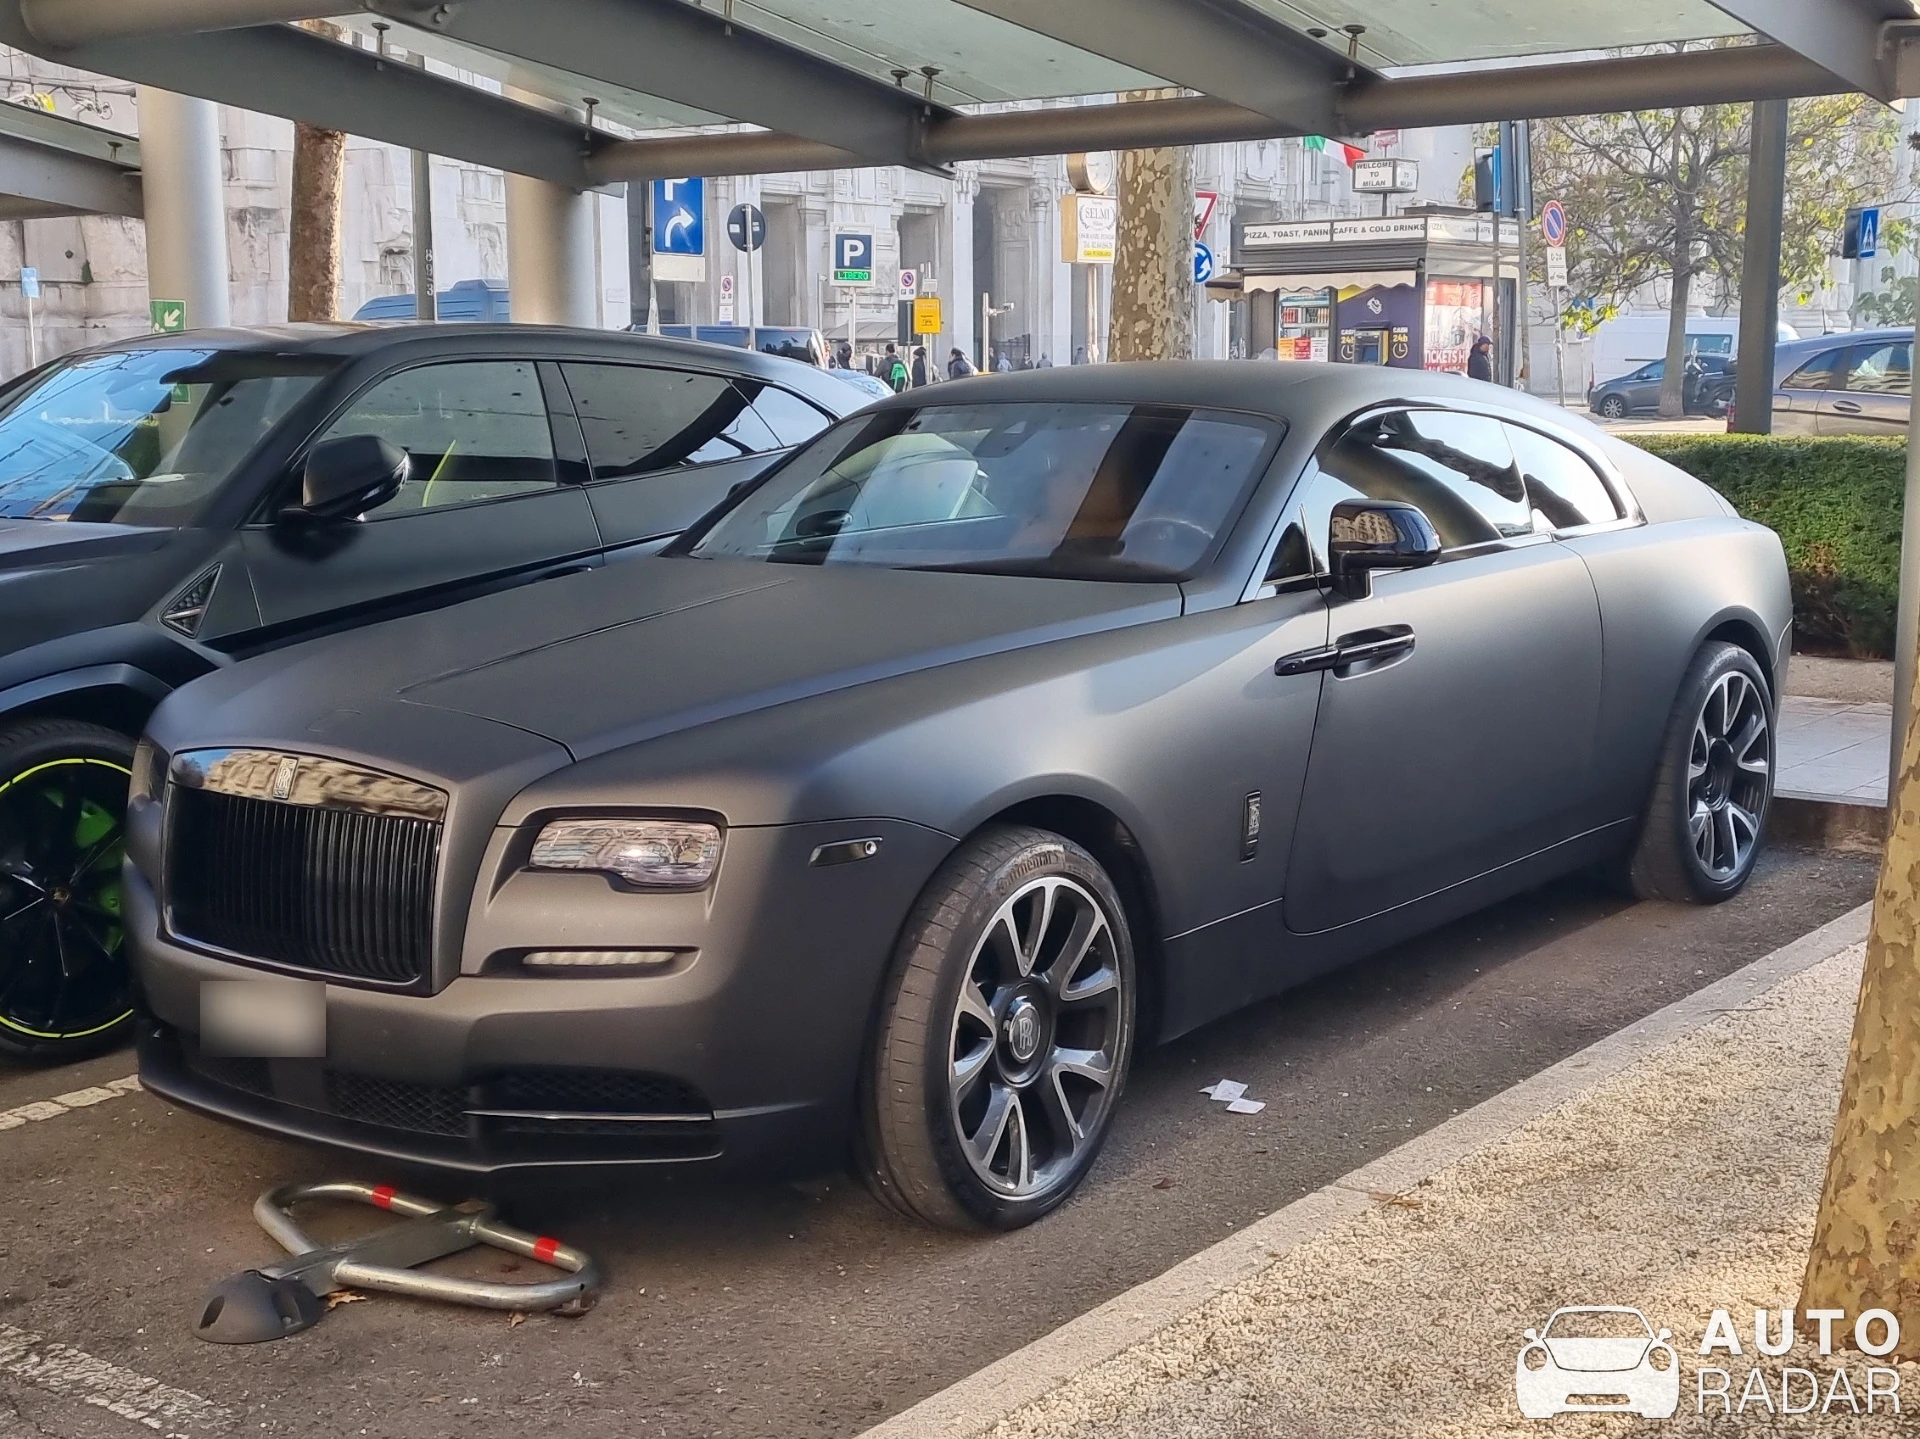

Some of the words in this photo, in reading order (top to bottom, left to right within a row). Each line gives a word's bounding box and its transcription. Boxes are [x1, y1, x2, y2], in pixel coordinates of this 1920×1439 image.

[1085, 207, 1110, 219] SELMI
[1273, 229, 1301, 238] TOAST,
[1333, 226, 1358, 234] CAFFE
[1361, 225, 1366, 233] &
[1369, 225, 1391, 233] COLD
[1394, 223, 1425, 232] DRINKS
[843, 239, 865, 267] P
[837, 271, 869, 280] LIBERO
[1393, 333, 1408, 342] 24h
[1425, 349, 1457, 363] TICKETS
